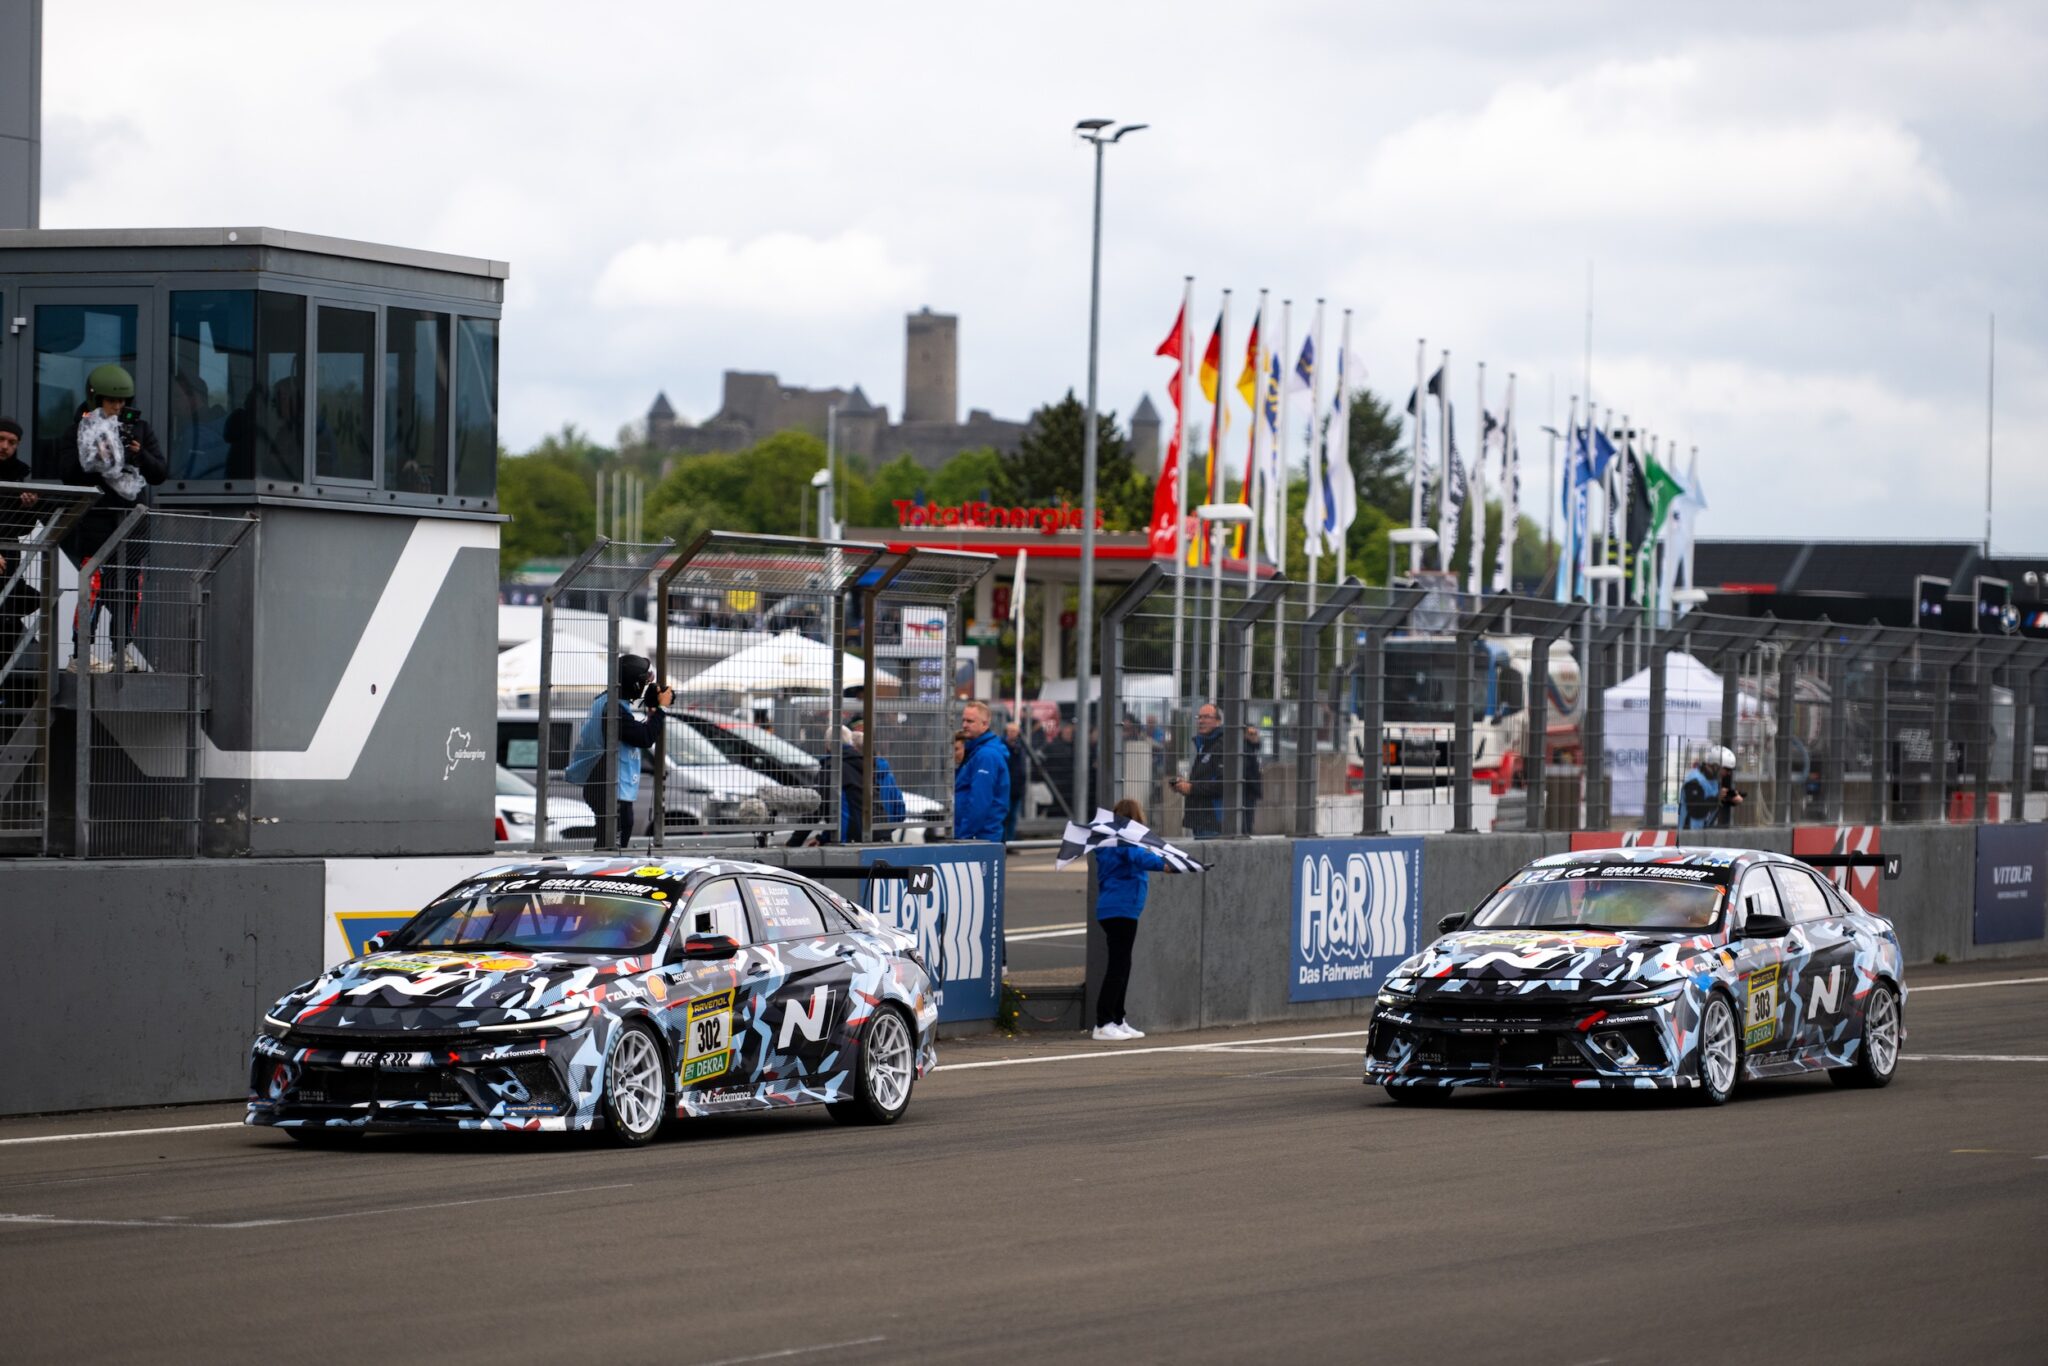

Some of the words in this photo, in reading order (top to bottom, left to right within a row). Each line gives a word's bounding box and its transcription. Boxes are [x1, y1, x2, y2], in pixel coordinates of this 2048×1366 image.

[1601, 866, 1643, 874] GRAN
[1644, 867, 1710, 878] TURISMO
[1994, 865, 2033, 884] VITOUR
[541, 878, 585, 888] GRAN
[586, 880, 654, 892] TURISMO
[1301, 854, 1372, 962] H&R
[1299, 965, 1320, 984] Das
[1322, 961, 1373, 983] Fahrwerk!
[1807, 964, 1846, 1020] N
[694, 996, 728, 1013] RAVENOL
[1754, 990, 1771, 1021] 303
[777, 985, 836, 1049] N
[697, 1017, 721, 1053] 302
[499, 1047, 546, 1059] Performance
[696, 1055, 724, 1077] DEKRA
[712, 1090, 751, 1103] Performance
